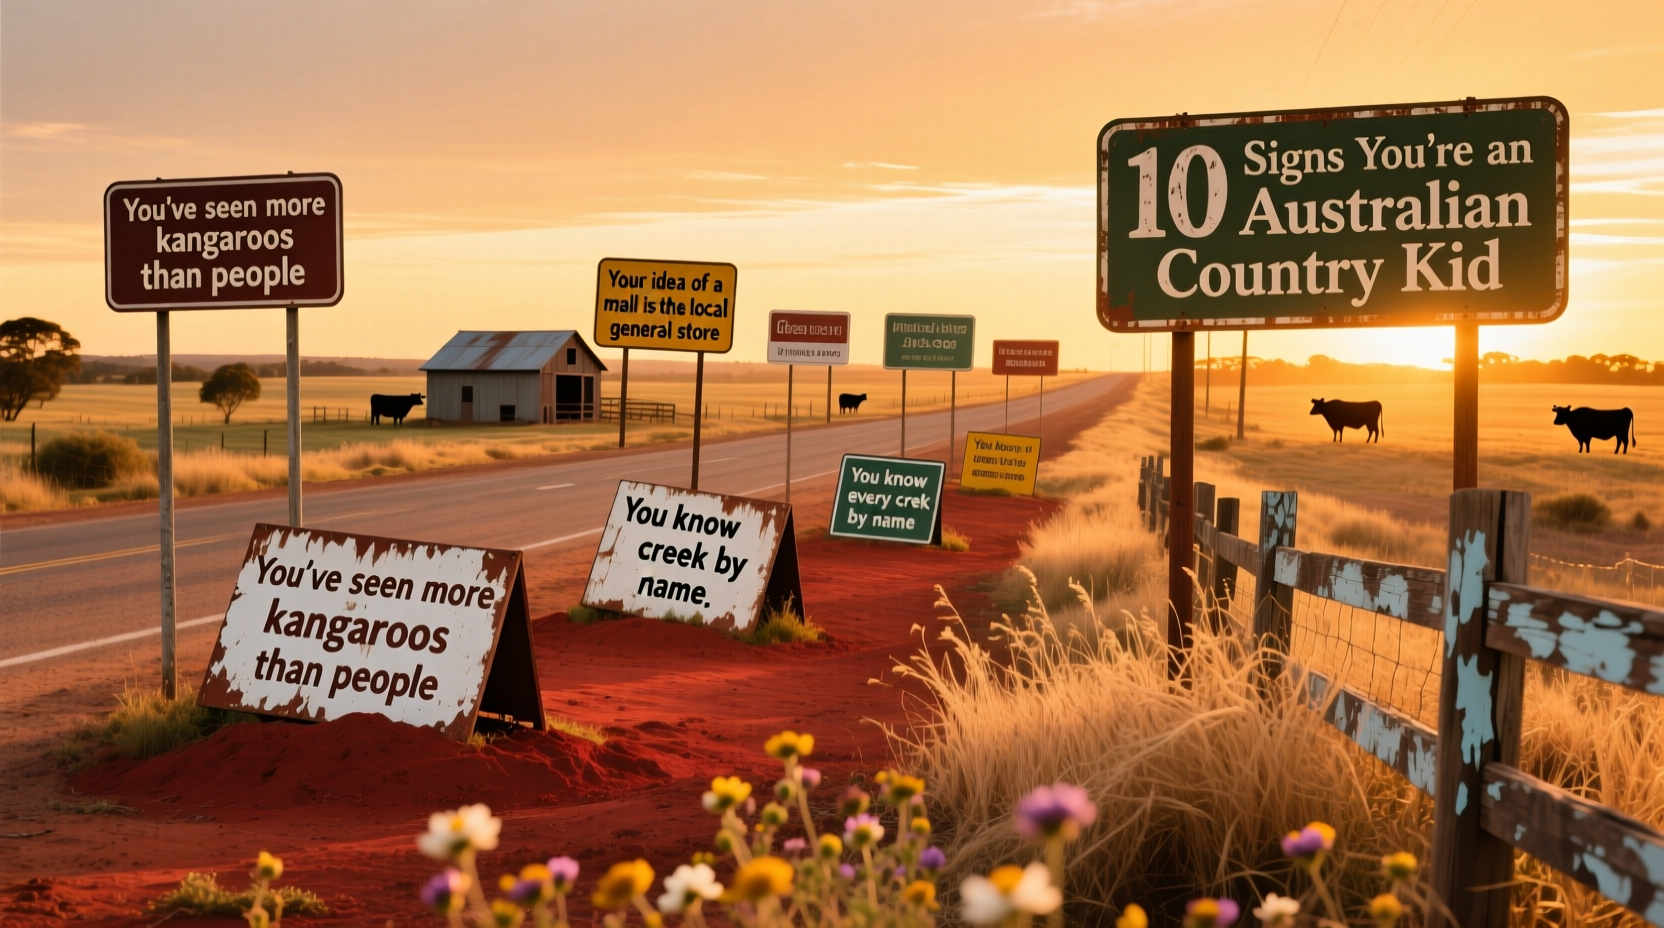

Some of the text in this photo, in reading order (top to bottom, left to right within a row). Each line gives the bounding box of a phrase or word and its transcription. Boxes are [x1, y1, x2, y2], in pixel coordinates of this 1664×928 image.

[1127, 133, 1533, 239] 10 Signs You're an
[123, 196, 325, 222] You've seen more
[1239, 179, 1532, 236] Australian
[156, 226, 294, 260] kangaroos
[141, 257, 305, 296] than people
[608, 269, 722, 292] Your idea of a
[1157, 238, 1503, 308] Country Kid
[604, 294, 728, 318] mall is the local
[610, 321, 719, 341] general store
[852, 467, 928, 488] You know
[626, 496, 741, 539] You know
[847, 508, 915, 529] by name
[848, 491, 930, 510] every crek
[638, 541, 748, 582] creek by
[256, 557, 495, 610] You've seen more
[637, 576, 710, 608] name.
[263, 598, 449, 654] kangaroos
[254, 650, 438, 706] than people
